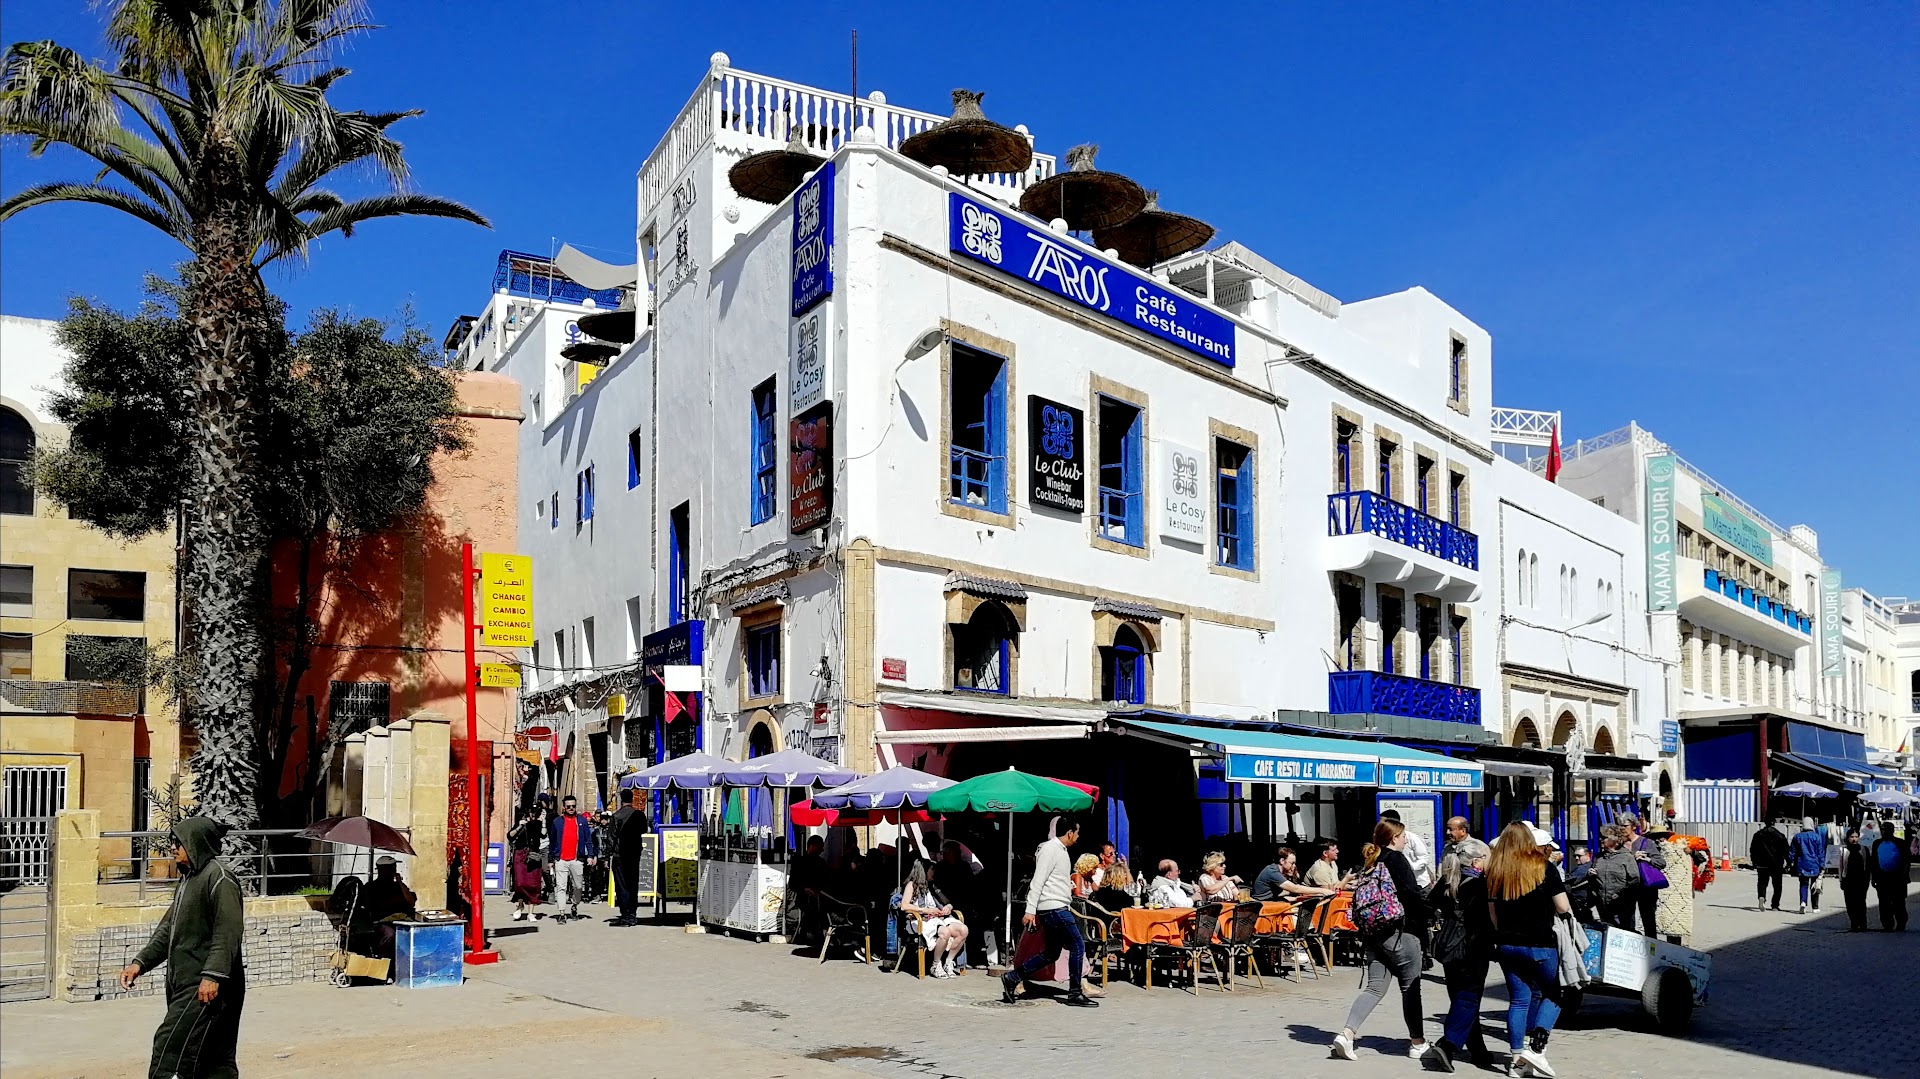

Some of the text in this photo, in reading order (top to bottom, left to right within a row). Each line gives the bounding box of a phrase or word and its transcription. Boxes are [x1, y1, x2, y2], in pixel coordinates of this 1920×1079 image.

[793, 227, 825, 282] TAROS
[1027, 232, 1110, 311] TAROS
[794, 280, 823, 311] Restaurant
[1135, 285, 1177, 316] Café
[1135, 305, 1230, 359] Restaurant
[792, 364, 825, 396] Le Cosy
[793, 383, 822, 412] Restaurant
[1035, 454, 1083, 481] Le Club
[791, 467, 826, 501] Le Club
[1045, 476, 1072, 492] Winebar
[1166, 497, 1206, 522] Le Cosy
[1168, 517, 1204, 535] Restaurant
[1712, 514, 1732, 539] Mama
[1653, 486, 1671, 606] MAMA SOUIRI
[493, 579, 525, 587] الصرف
[492, 593, 526, 601] CHANGE
[493, 607, 526, 615] CAMBIO
[488, 620, 531, 629] EXCHANGE
[490, 633, 527, 642] WECHSEL
[1826, 591, 1840, 672] MAMA SOUIRI
[1254, 760, 1356, 780] CAFE RESTO LE MARRAKECH
[1395, 769, 1472, 787] CAFE RESTO LE MARRAKECH
